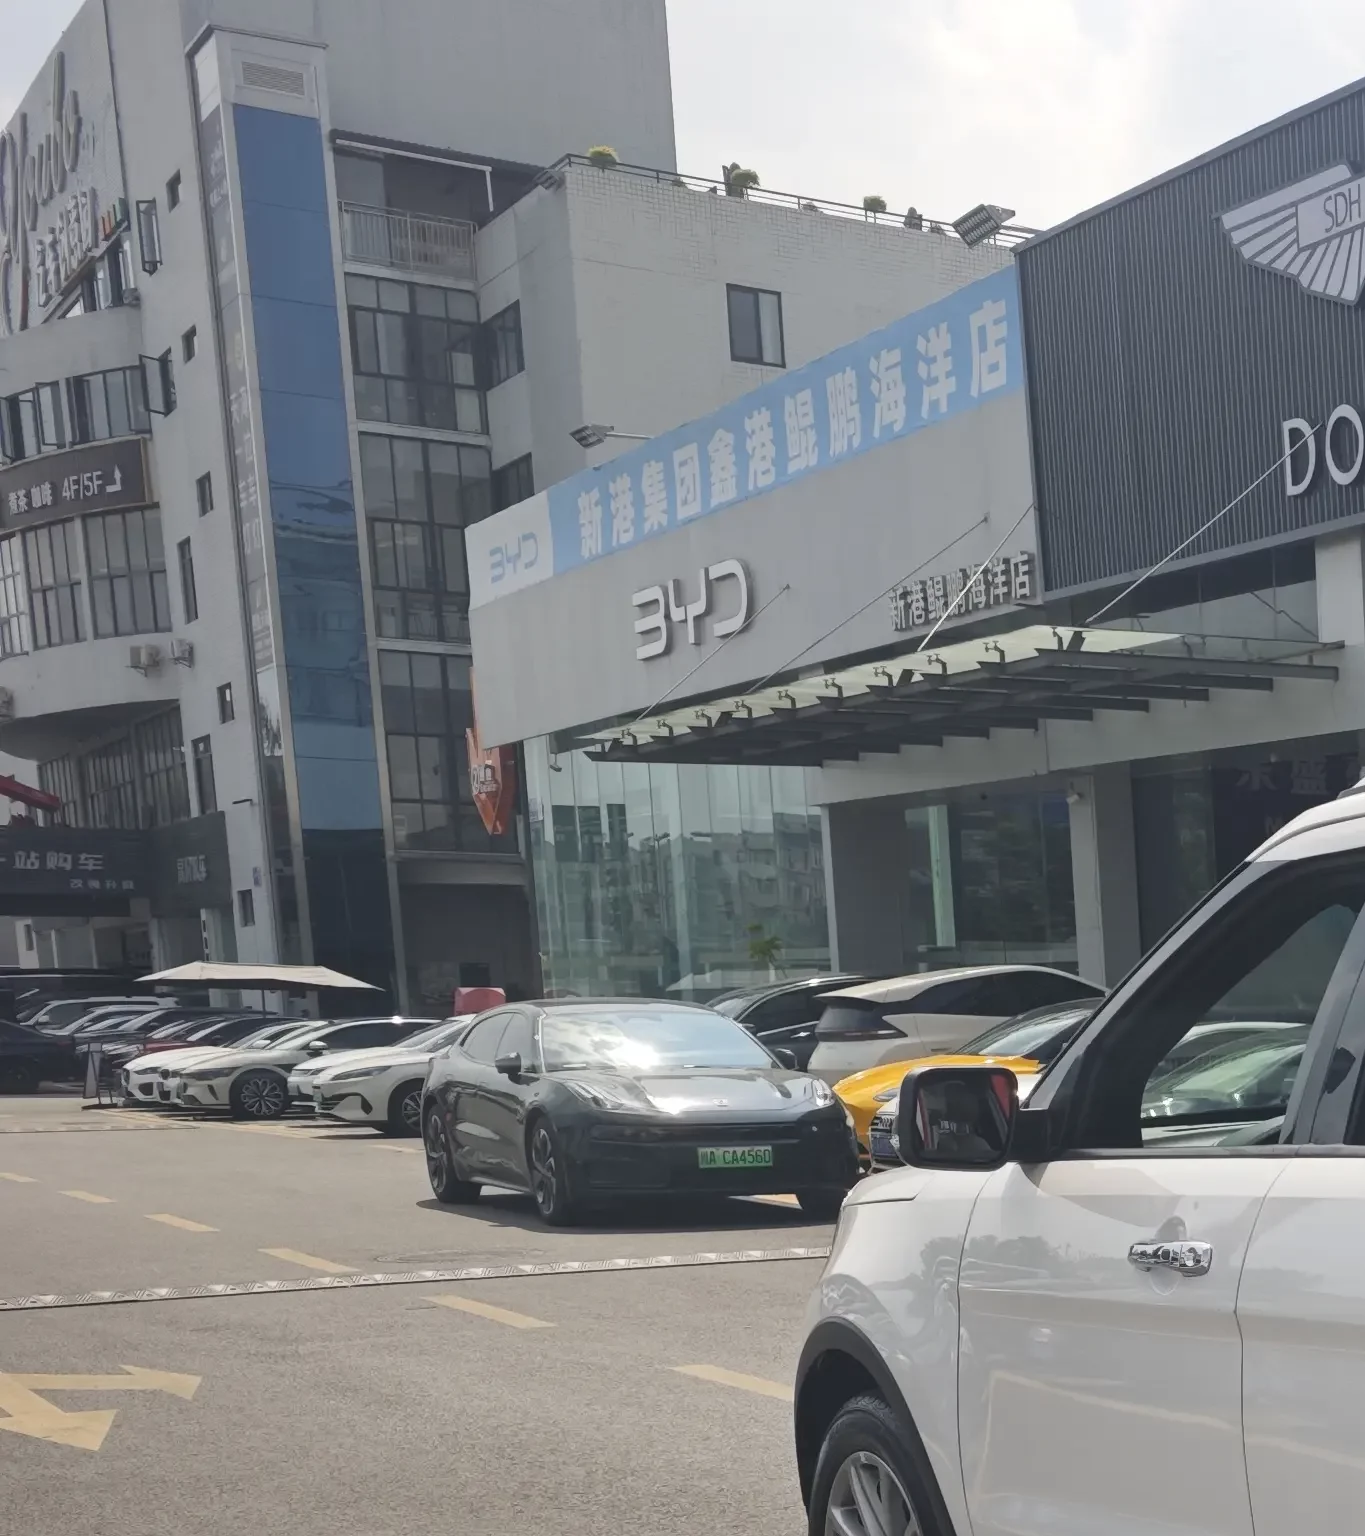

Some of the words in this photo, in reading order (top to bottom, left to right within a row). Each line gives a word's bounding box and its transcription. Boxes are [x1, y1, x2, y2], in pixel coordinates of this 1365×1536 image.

[1323, 187, 1363, 235] SDH
[577, 297, 1009, 561] 新港集团鑫港鲲鹏海洋店
[489, 531, 539, 585] BYD
[632, 557, 750, 661] BYD
